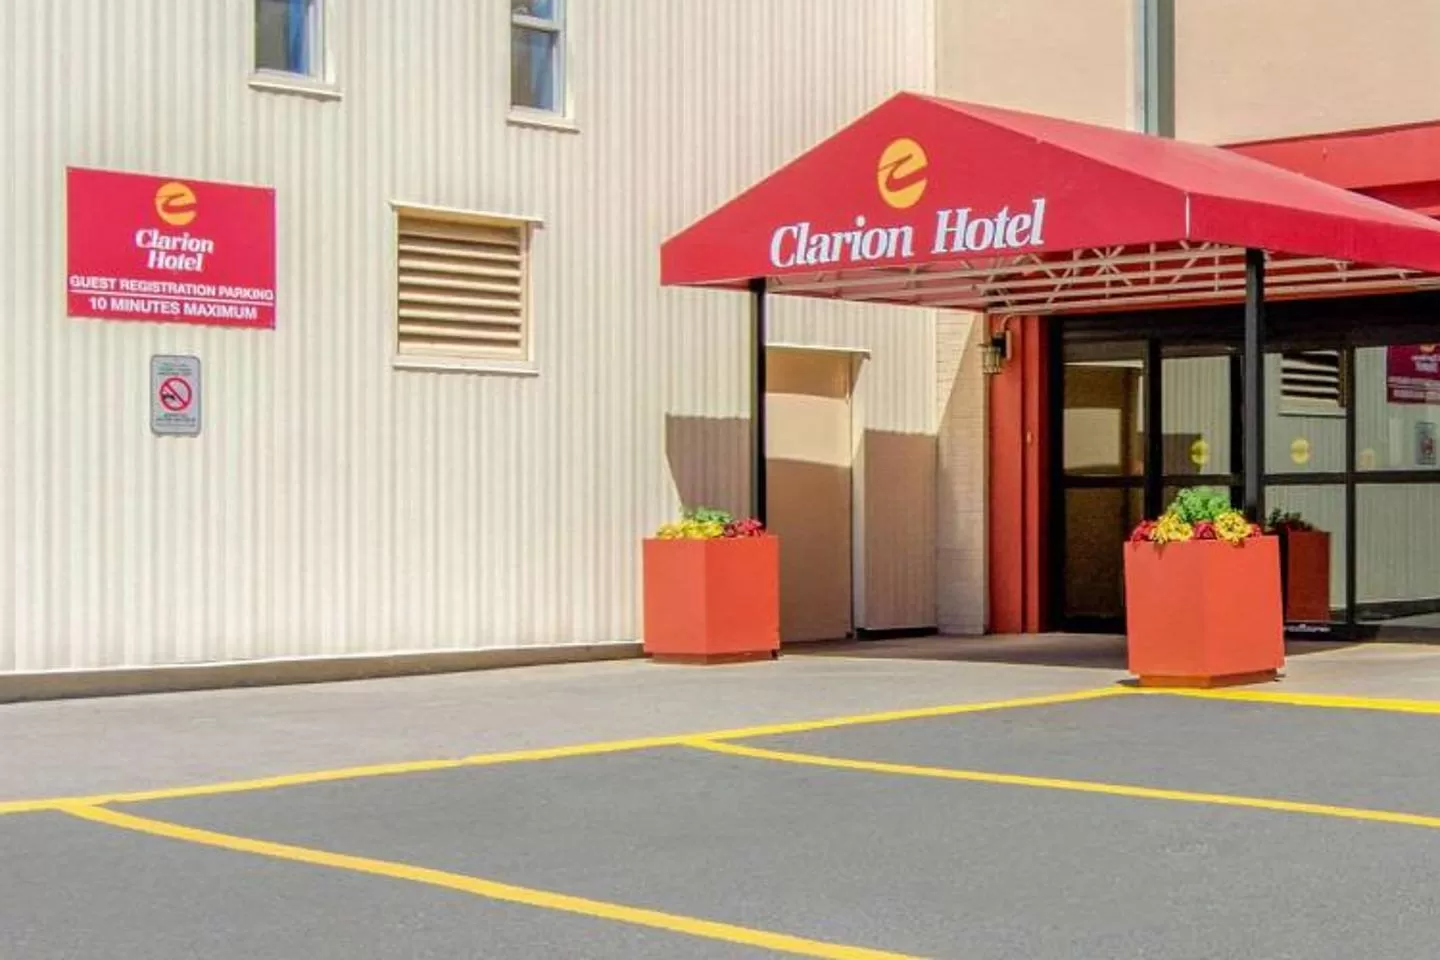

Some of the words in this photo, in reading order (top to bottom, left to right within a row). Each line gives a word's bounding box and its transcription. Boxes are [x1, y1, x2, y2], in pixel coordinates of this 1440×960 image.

[135, 228, 214, 254] Clarion
[769, 215, 914, 268] Clarion
[930, 198, 1047, 254] Hotel
[147, 249, 204, 272] Hotel
[69, 275, 117, 290] GUEST
[119, 278, 216, 297] REGISTRATION
[218, 285, 274, 301] PARKING
[88, 297, 107, 311] 10
[110, 298, 181, 315] MINUTES
[183, 303, 258, 320] MAXIMUM
